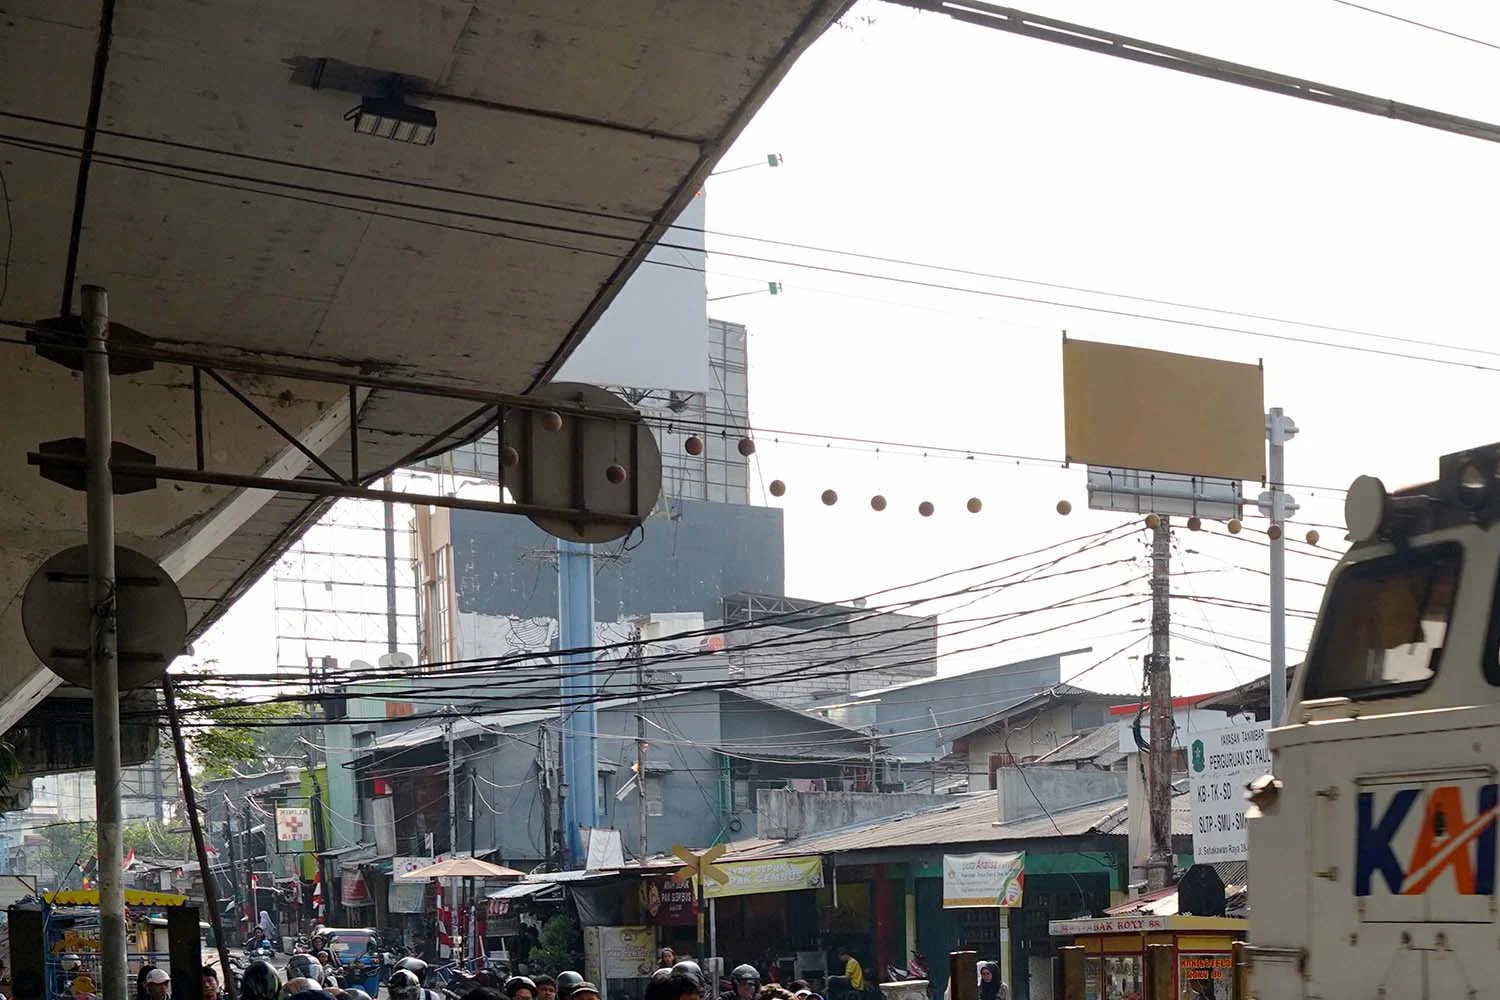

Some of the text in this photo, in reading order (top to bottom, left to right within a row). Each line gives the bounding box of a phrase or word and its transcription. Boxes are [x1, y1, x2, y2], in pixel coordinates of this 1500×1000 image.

[1209, 751, 1245, 770] PERGURUAN
[1245, 749, 1254, 766] ST.
[1197, 784, 1207, 803] KB
[1210, 783, 1220, 801] TK
[1223, 782, 1232, 800] SD
[1199, 815, 1213, 834] SLTP
[1217, 813, 1231, 832] SMU
[1355, 784, 1500, 896] KAI
[1118, 920, 1145, 931] ROXY
